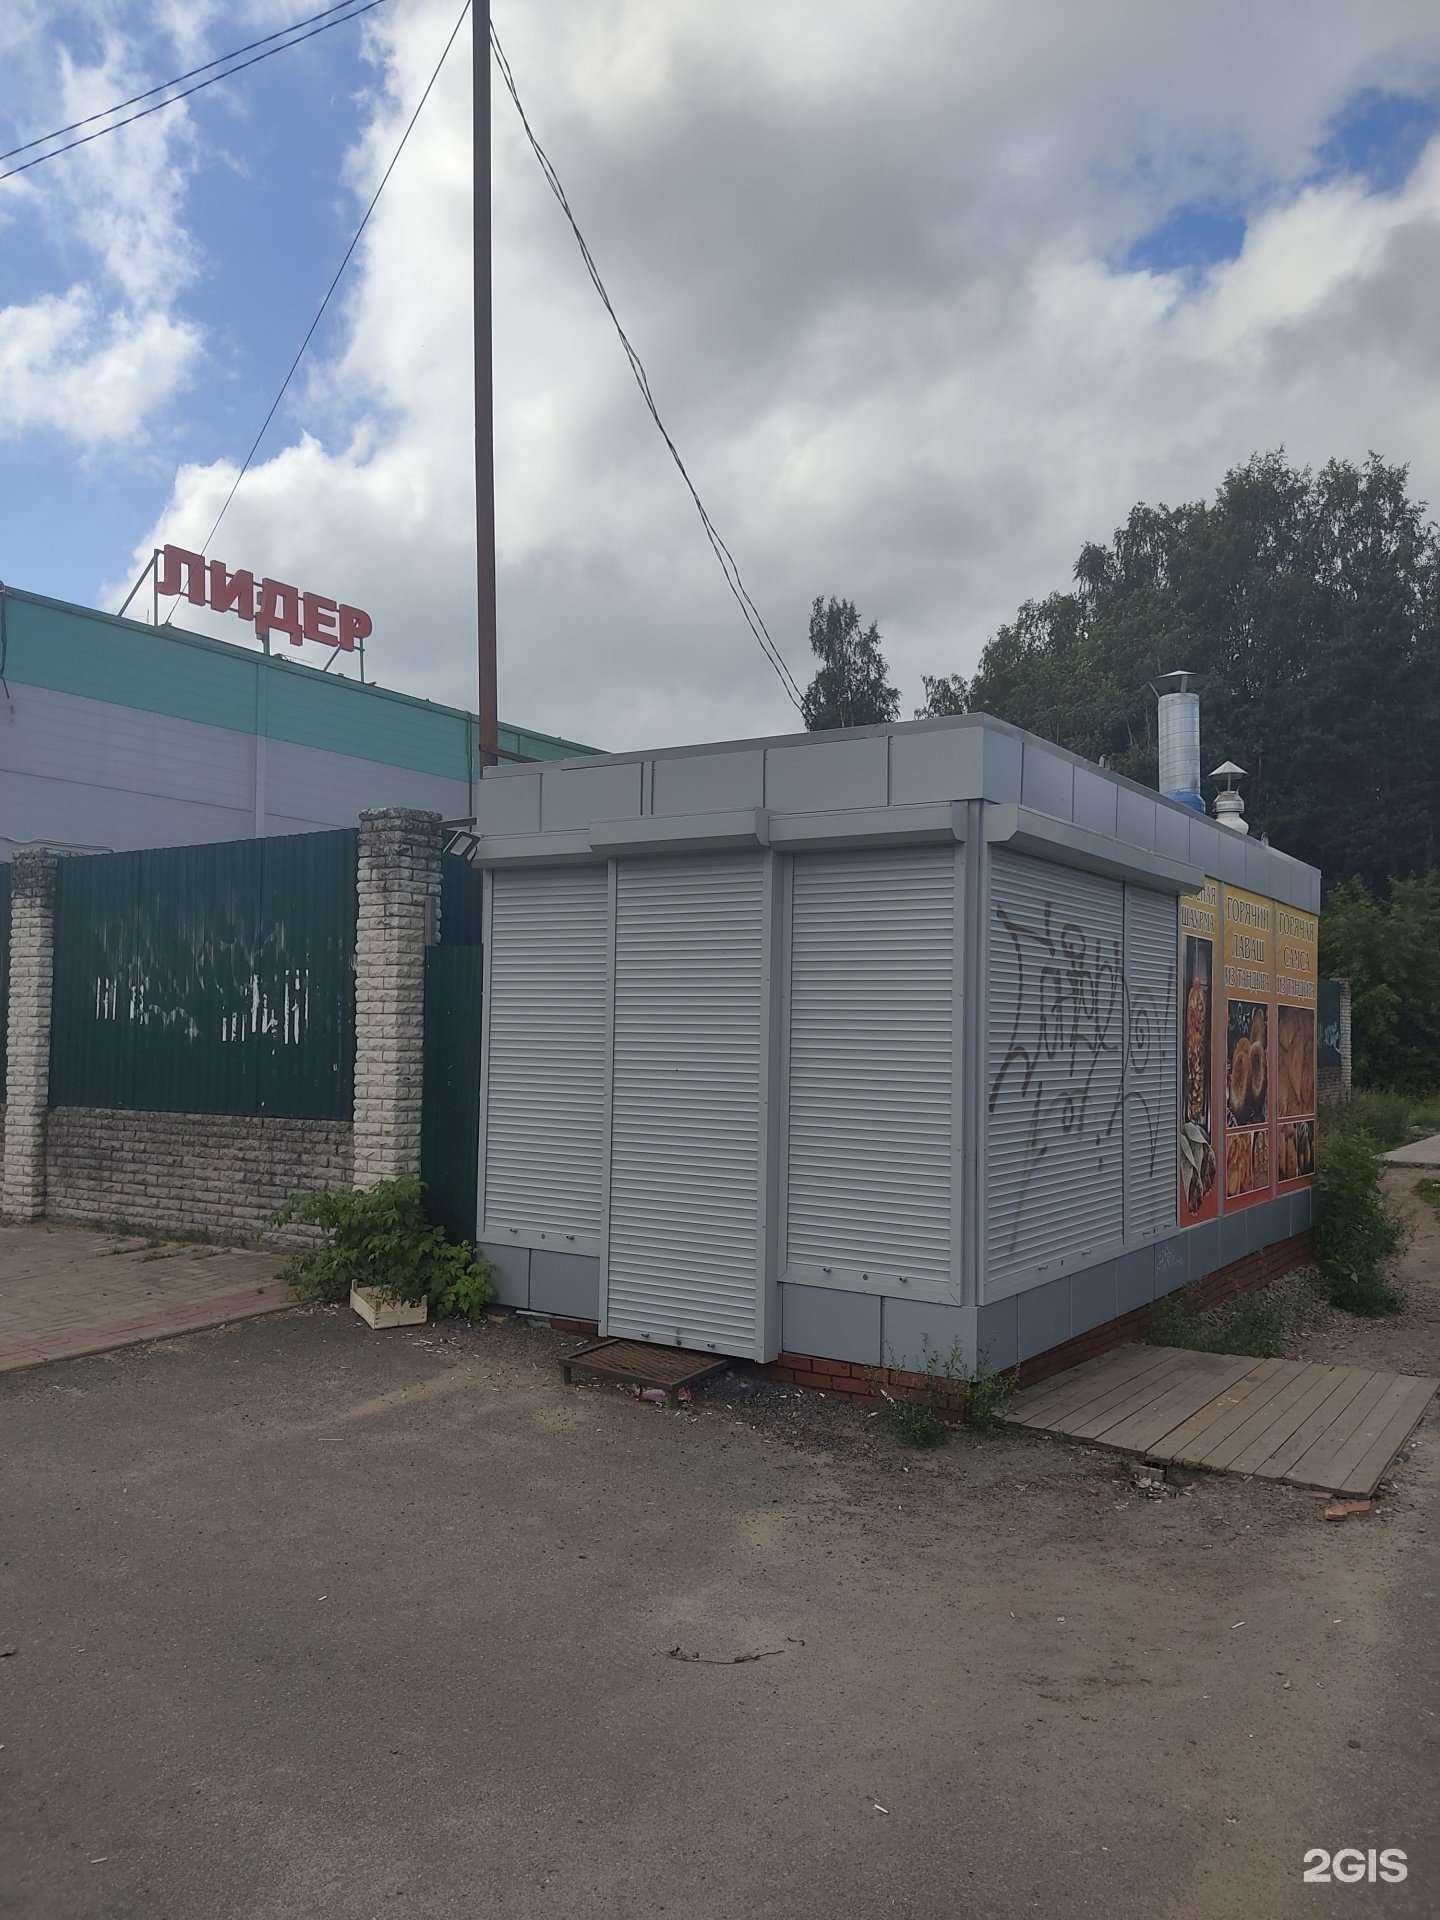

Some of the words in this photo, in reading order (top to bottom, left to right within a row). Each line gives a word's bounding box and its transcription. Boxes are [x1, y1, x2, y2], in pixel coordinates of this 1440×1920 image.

[157, 544, 372, 652] ЛИДЕР
[1180, 905, 1215, 933] ШАУРМА
[1226, 895, 1271, 932] ГОРЯЧИЙ
[1279, 912, 1315, 943] ГОРЯЧАЯ
[1233, 932, 1265, 964] ЛАВАШ
[1282, 944, 1313, 973] САМСА
[1224, 966, 1236, 987] ИЗ
